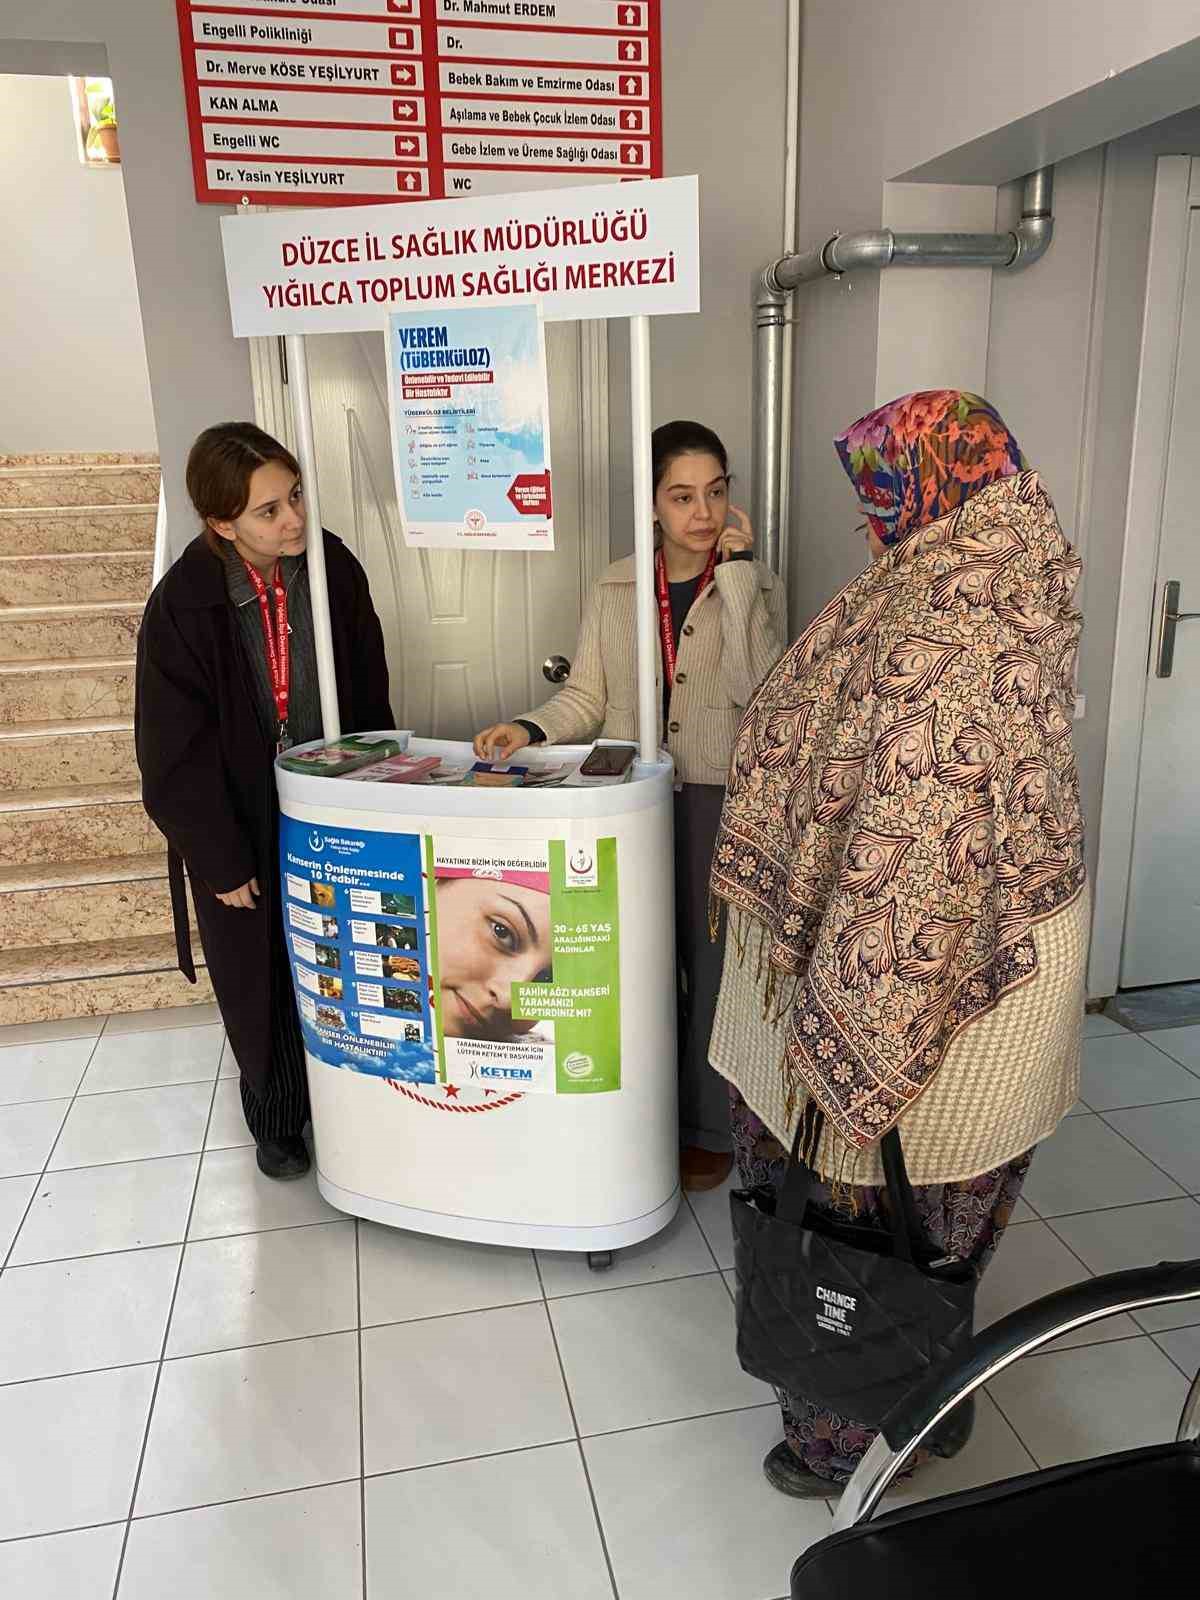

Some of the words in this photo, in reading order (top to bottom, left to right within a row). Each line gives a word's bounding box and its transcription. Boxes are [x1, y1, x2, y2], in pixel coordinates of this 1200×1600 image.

[443, 0, 460, 11] Dr.
[463, 0, 511, 15] Mahmut
[514, 3, 556, 17] ERDEM
[202, 23, 246, 40] Engelli
[251, 25, 312, 44] Polikliniği
[447, 36, 463, 49] Dr.
[206, 60, 223, 74] Dr.
[228, 62, 266, 76] Merve
[270, 62, 305, 78] KÖSE
[308, 64, 379, 82] YEŞİLYURT
[448, 73, 482, 86] Bebek
[486, 74, 519, 88] Bakım
[522, 79, 534, 88] ve
[537, 77, 582, 90] Emzirme
[586, 79, 615, 92] Odası
[210, 97, 238, 111] KAN
[242, 99, 279, 112] ALMA
[450, 108, 487, 122] Aşılama
[490, 113, 500, 122] ve
[503, 111, 531, 124] Bebek
[534, 112, 562, 127] Çocuk
[564, 110, 588, 125] İzlem
[591, 114, 616, 128] Odası
[213, 134, 256, 150] Engelli
[260, 136, 280, 148] WC
[452, 144, 477, 157] Gebe
[480, 142, 506, 157] İzlem
[509, 149, 520, 158] ve
[523, 144, 554, 159] Üreme
[557, 147, 588, 163] Sağlığı
[591, 148, 618, 161] Odası
[217, 169, 234, 182] Dr.
[237, 170, 271, 184] Yasin
[274, 169, 345, 187] YEŞİLYURT
[453, 178, 472, 190] WC
[282, 235, 360, 267] DÜZCE
[365, 231, 386, 261] İL
[392, 226, 479, 259] SAĞLIK
[483, 208, 648, 253] MÜDÜRLÜĞÜ
[263, 277, 353, 309] YIĞILCA
[357, 273, 456, 304] TOPLUM
[462, 260, 559, 298] SAĞLIĞI
[564, 251, 676, 291] MERKEZİ
[399, 326, 448, 349] VEREM
[401, 347, 491, 371] (TÜBERKÜLOZ)
[287, 853, 322, 871] Kanserin
[325, 861, 405, 881] Önlenmesinde
[437, 857, 470, 866] HAYATINIZ
[472, 858, 491, 866] BİZİM
[492, 858, 506, 868] İÇİN
[507, 858, 547, 869] DEĞERLİDİR
[311, 869, 323, 880] 10
[554, 925, 567, 934] 30
[519, 986, 548, 997] RAHİM
[519, 998, 574, 1008] TARAMANIZI
[480, 1066, 533, 1079] KETEM
[816, 1286, 857, 1312] CHANGE
[824, 1303, 847, 1322] TIME
